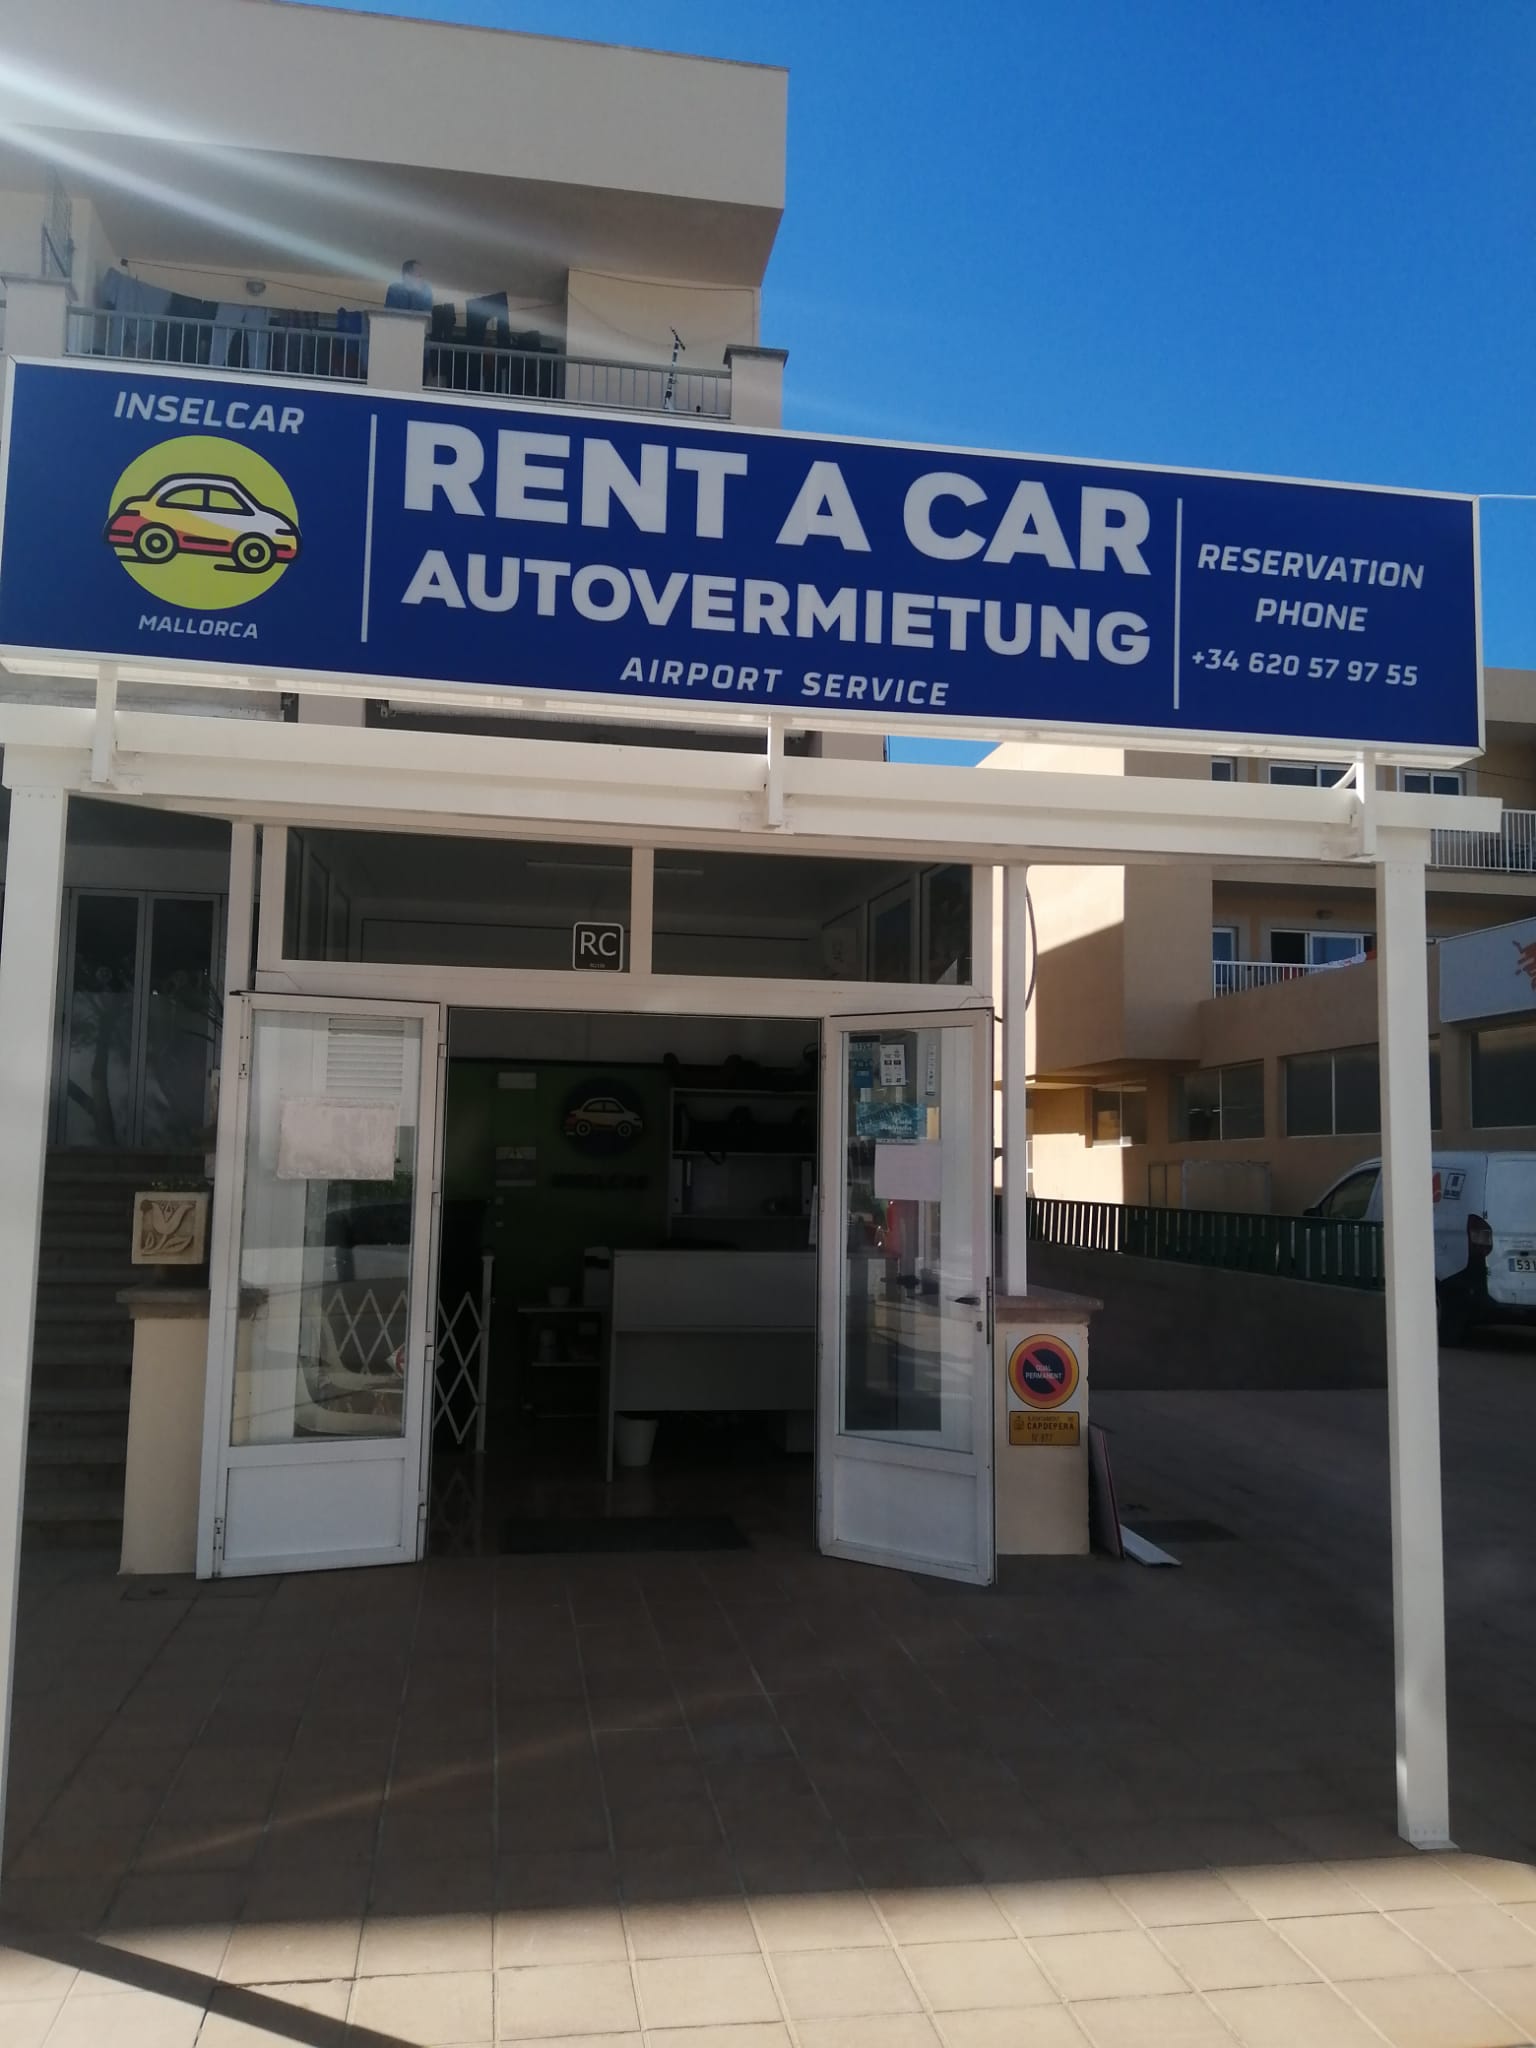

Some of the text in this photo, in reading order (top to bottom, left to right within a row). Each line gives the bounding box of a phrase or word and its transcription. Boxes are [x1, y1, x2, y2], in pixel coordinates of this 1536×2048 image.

[114, 391, 305, 435] INSELCAR
[404, 420, 1151, 576] RENT A CAR
[1197, 543, 1425, 590] RESERVATION
[138, 614, 259, 640] MALLORCA
[401, 549, 1151, 667] AUTOVERMIETUNG
[1255, 598, 1368, 633] PHONE
[619, 656, 950, 708] AIRPORT SERVICE
[1192, 649, 1419, 687] +34 620 57 97 55
[580, 930, 618, 957] RC
[1027, 1422, 1074, 1431] CAPDEPERA
